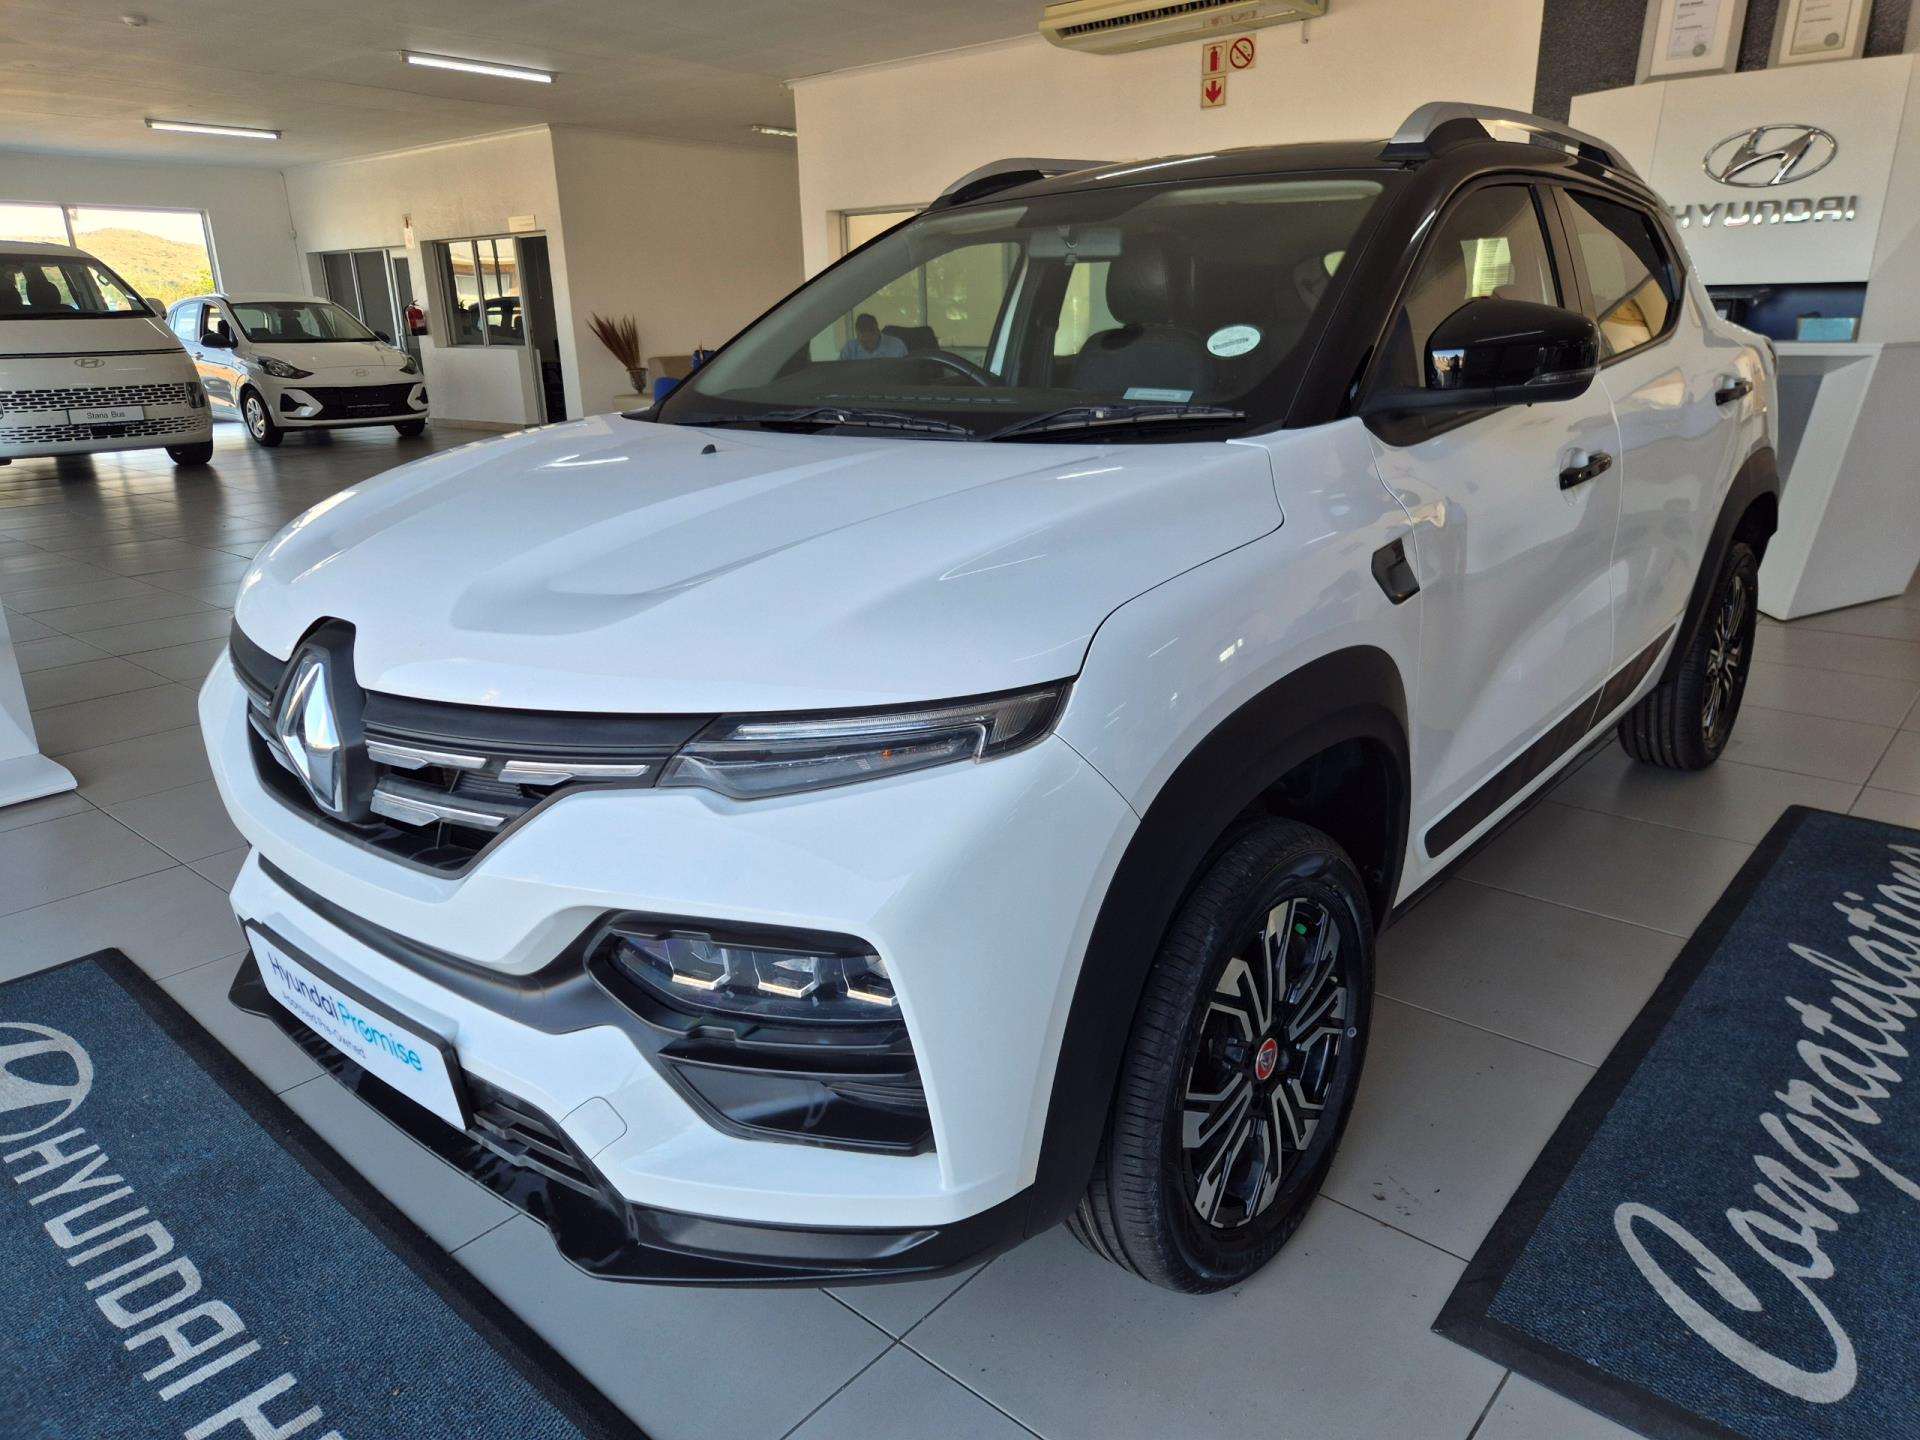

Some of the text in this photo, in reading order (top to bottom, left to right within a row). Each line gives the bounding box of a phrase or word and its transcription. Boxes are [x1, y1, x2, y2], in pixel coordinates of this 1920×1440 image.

[1669, 194, 1858, 229] HYUNDAI
[267, 952, 423, 1072] Hyundai Promise
[2, 1127, 262, 1401] HYUNDAI
